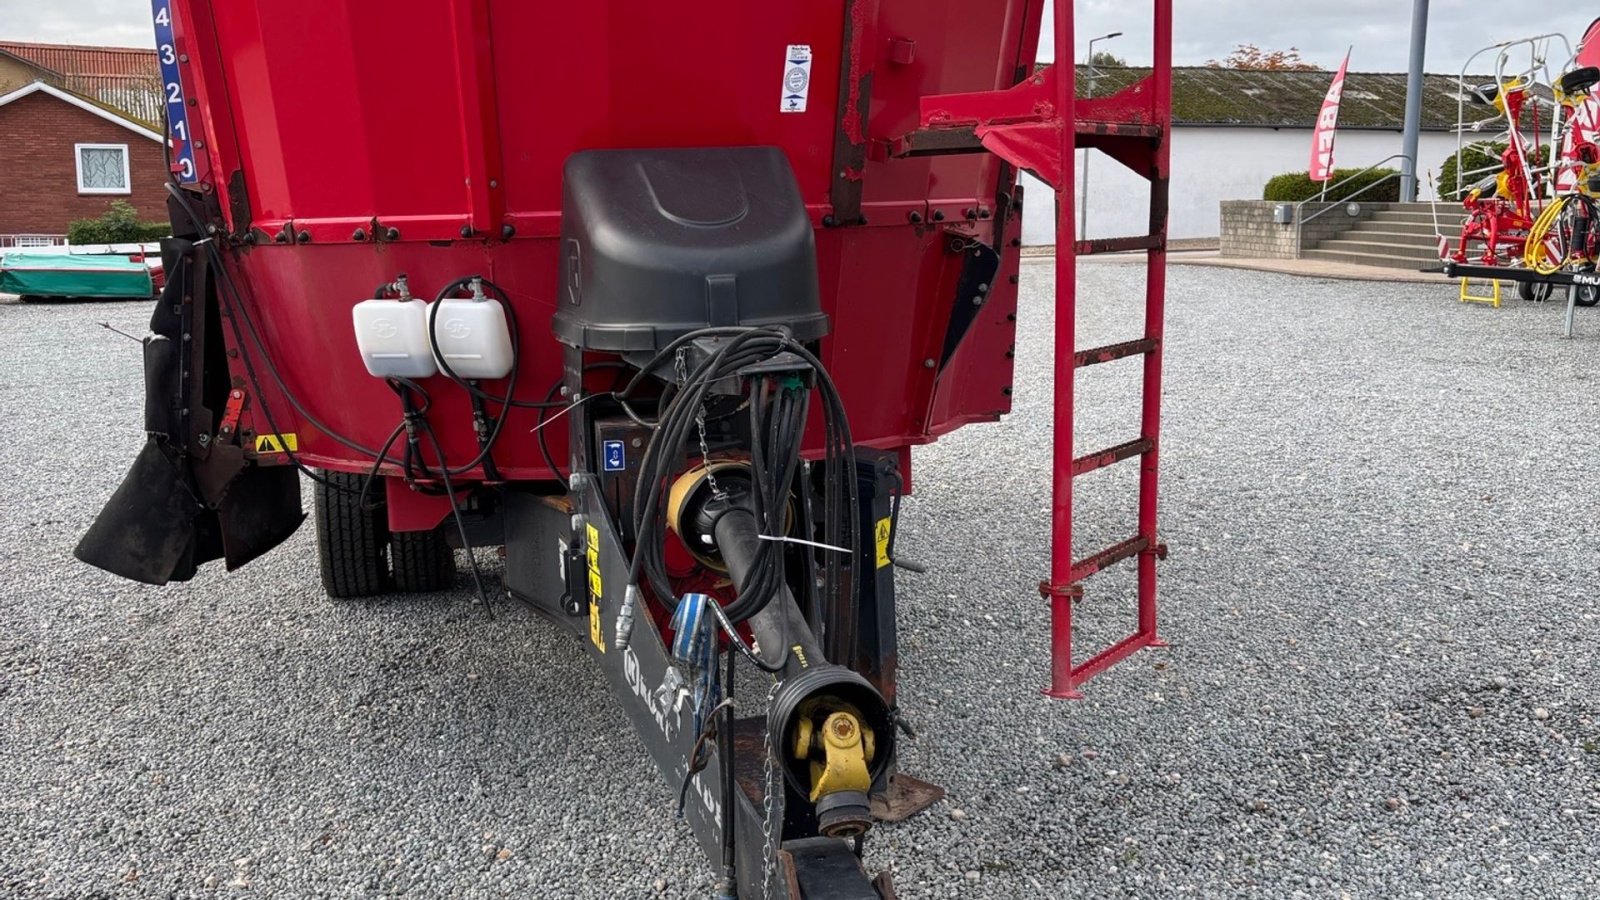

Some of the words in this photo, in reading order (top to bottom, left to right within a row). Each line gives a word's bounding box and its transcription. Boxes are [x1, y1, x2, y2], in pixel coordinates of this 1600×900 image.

[155, 7, 170, 26] 4
[160, 44, 175, 65] 3
[166, 82, 182, 103] 2
[175, 120, 187, 141] 1
[178, 157, 193, 178] 0
